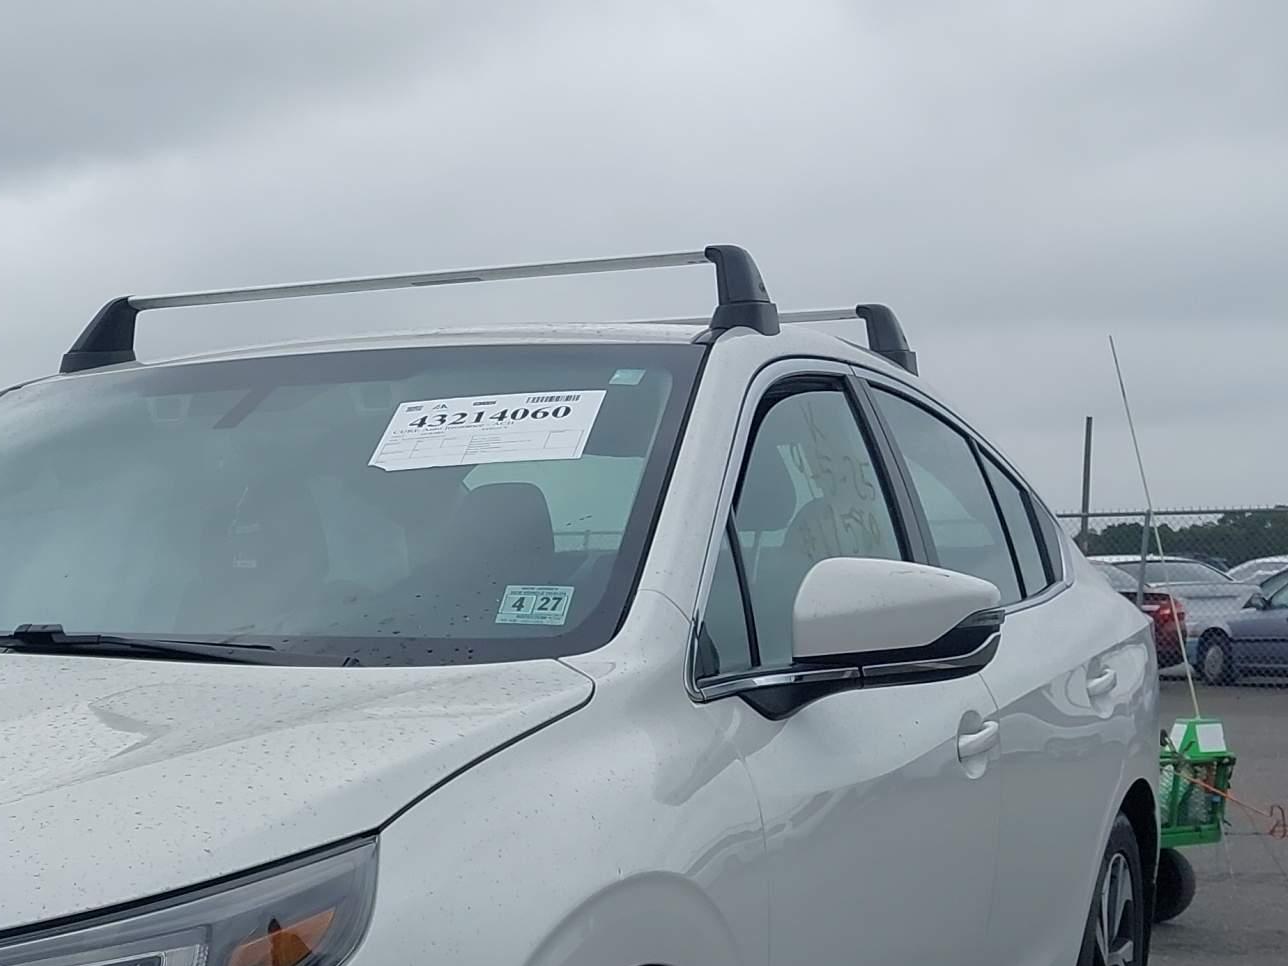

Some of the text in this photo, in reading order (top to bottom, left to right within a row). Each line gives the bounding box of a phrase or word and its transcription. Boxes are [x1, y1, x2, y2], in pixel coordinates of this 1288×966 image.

[409, 405, 572, 428] 43214060
[511, 596, 563, 612] 4 27
